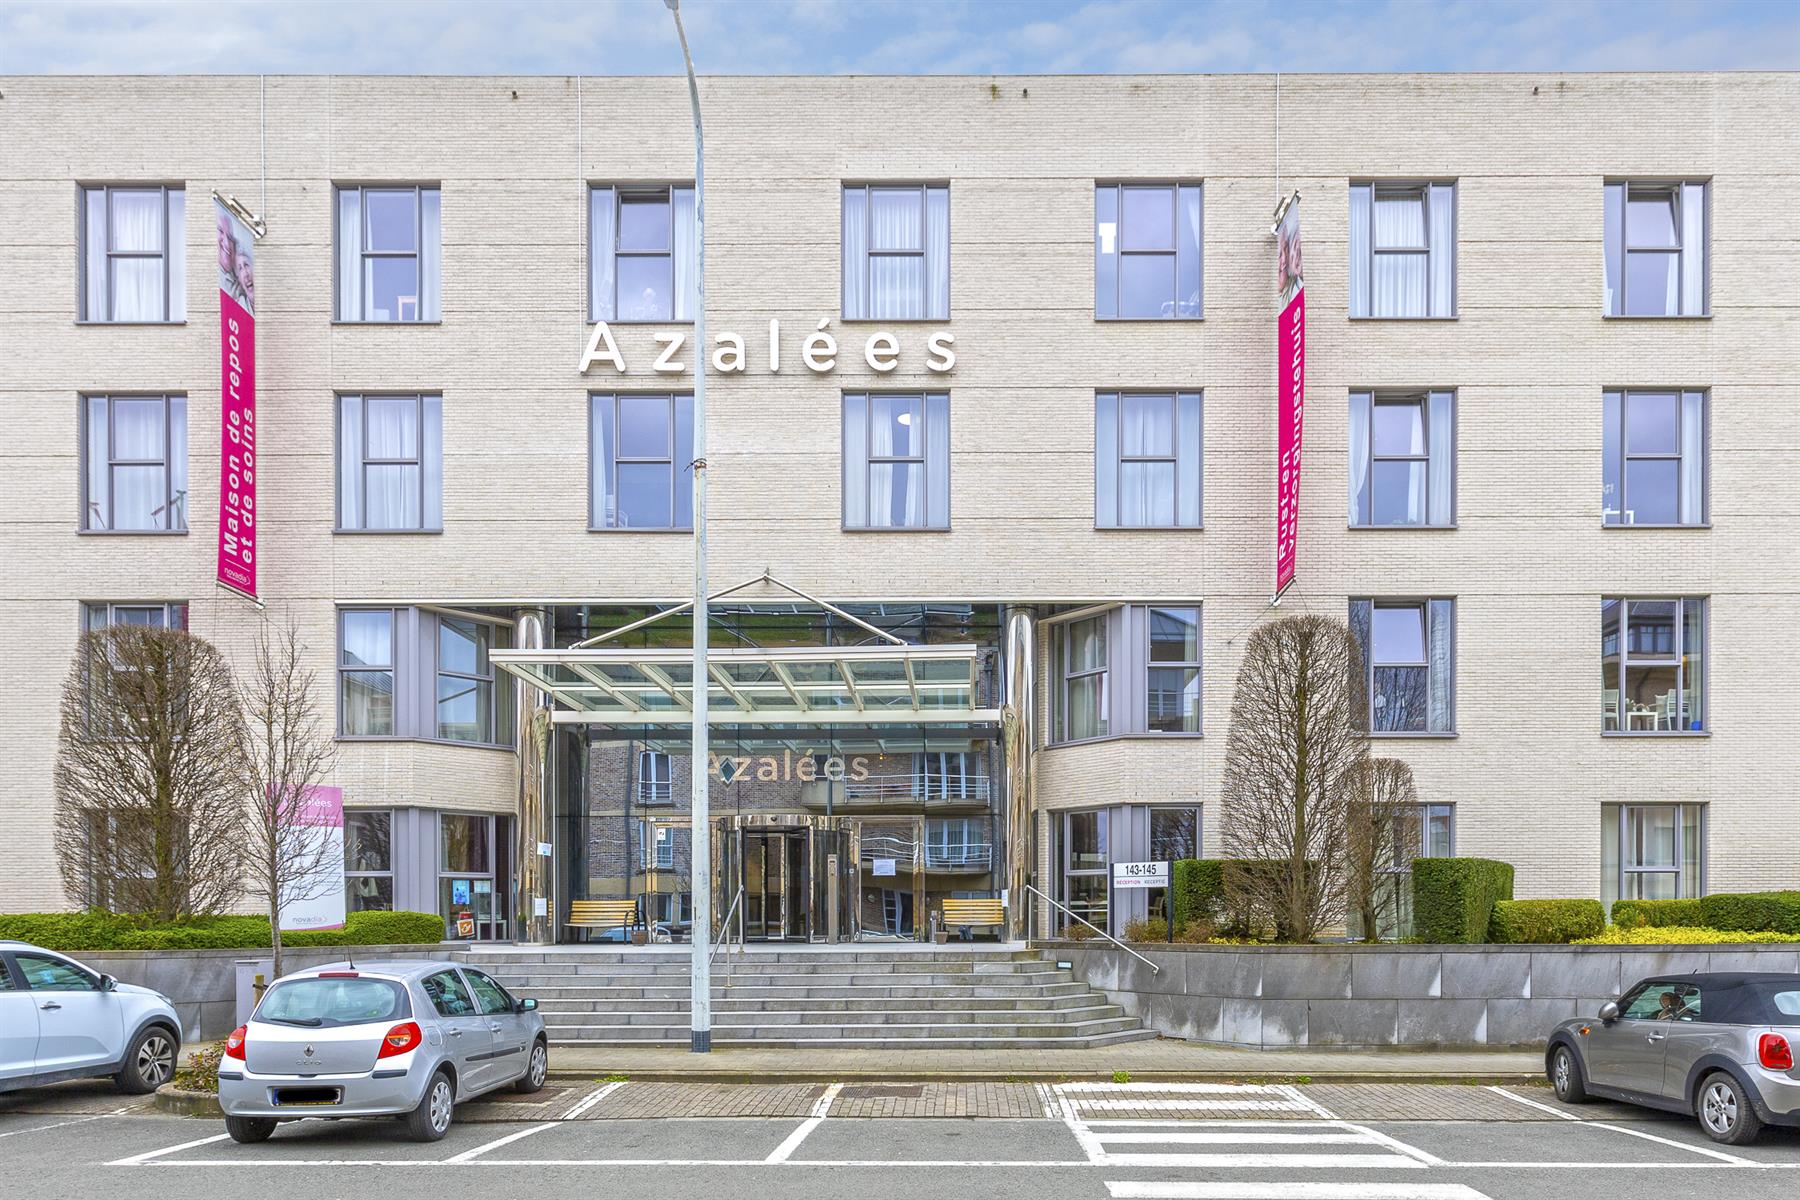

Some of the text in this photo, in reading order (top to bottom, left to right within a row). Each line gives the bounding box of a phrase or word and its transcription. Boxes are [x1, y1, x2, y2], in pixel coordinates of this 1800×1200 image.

[578, 317, 956, 374] Azalées
[223, 317, 242, 556] Maison de repos
[240, 407, 253, 564] et de soins
[1288, 306, 1302, 553] verzorgingstehuis
[1279, 450, 1290, 561] Rust-en
[1125, 864, 1157, 876] 143-145
